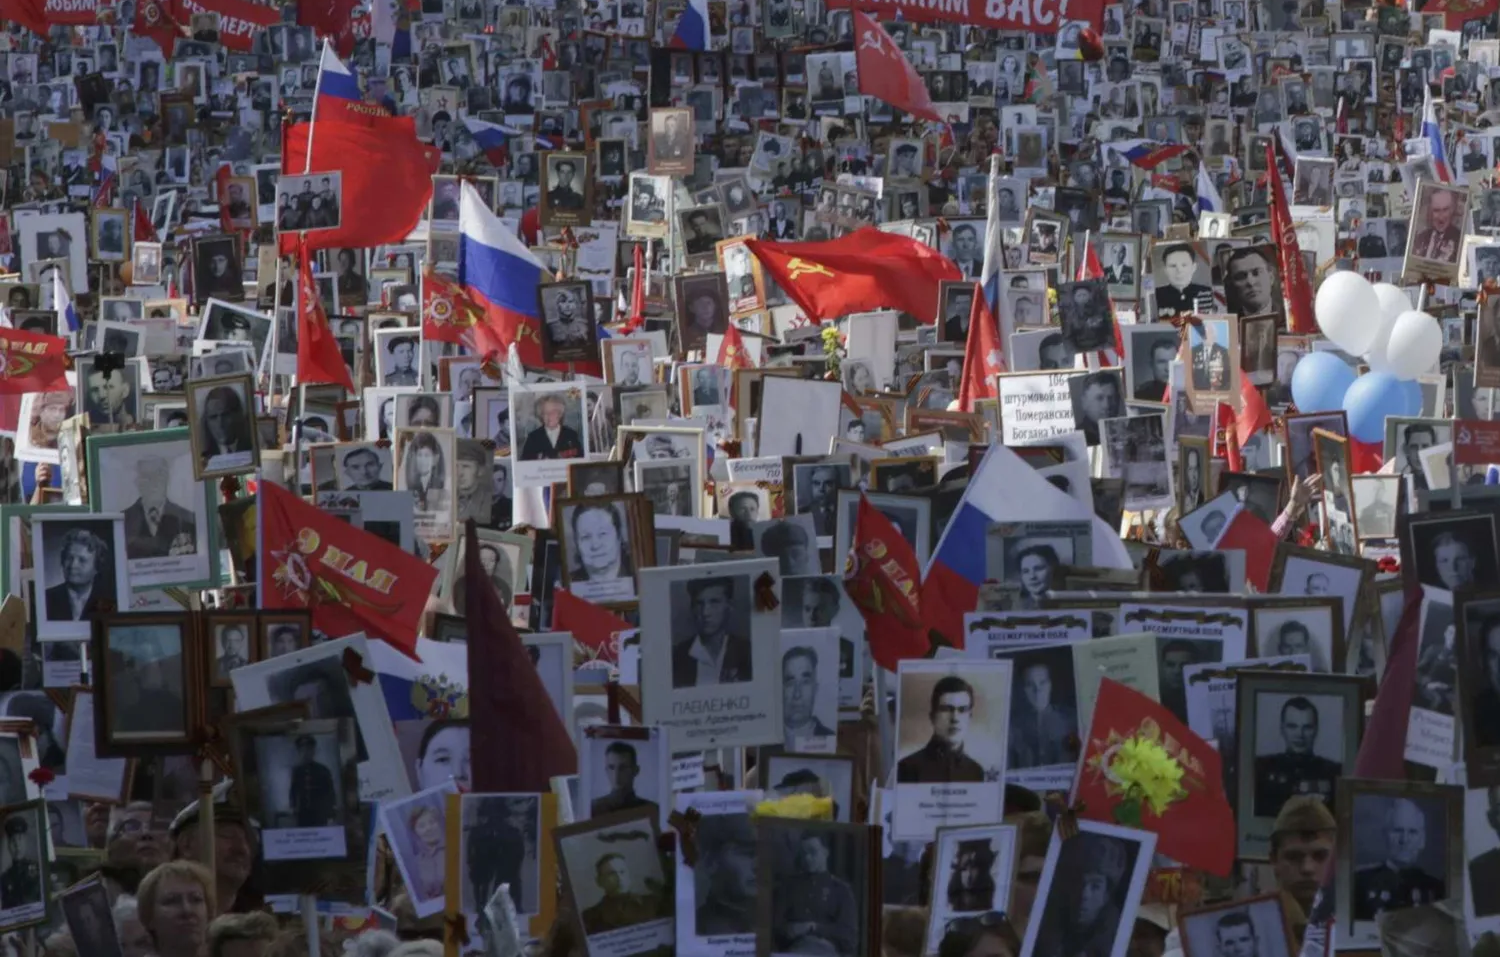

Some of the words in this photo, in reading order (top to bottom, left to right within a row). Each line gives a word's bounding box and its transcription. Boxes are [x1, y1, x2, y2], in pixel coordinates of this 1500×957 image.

[1004, 390, 1055, 412] штурмовой
[1012, 427, 1048, 440] Богдана
[297, 527, 321, 554] 9
[318, 544, 398, 594] МАЯ
[672, 696, 750, 716] ПАВЛЕНКО
